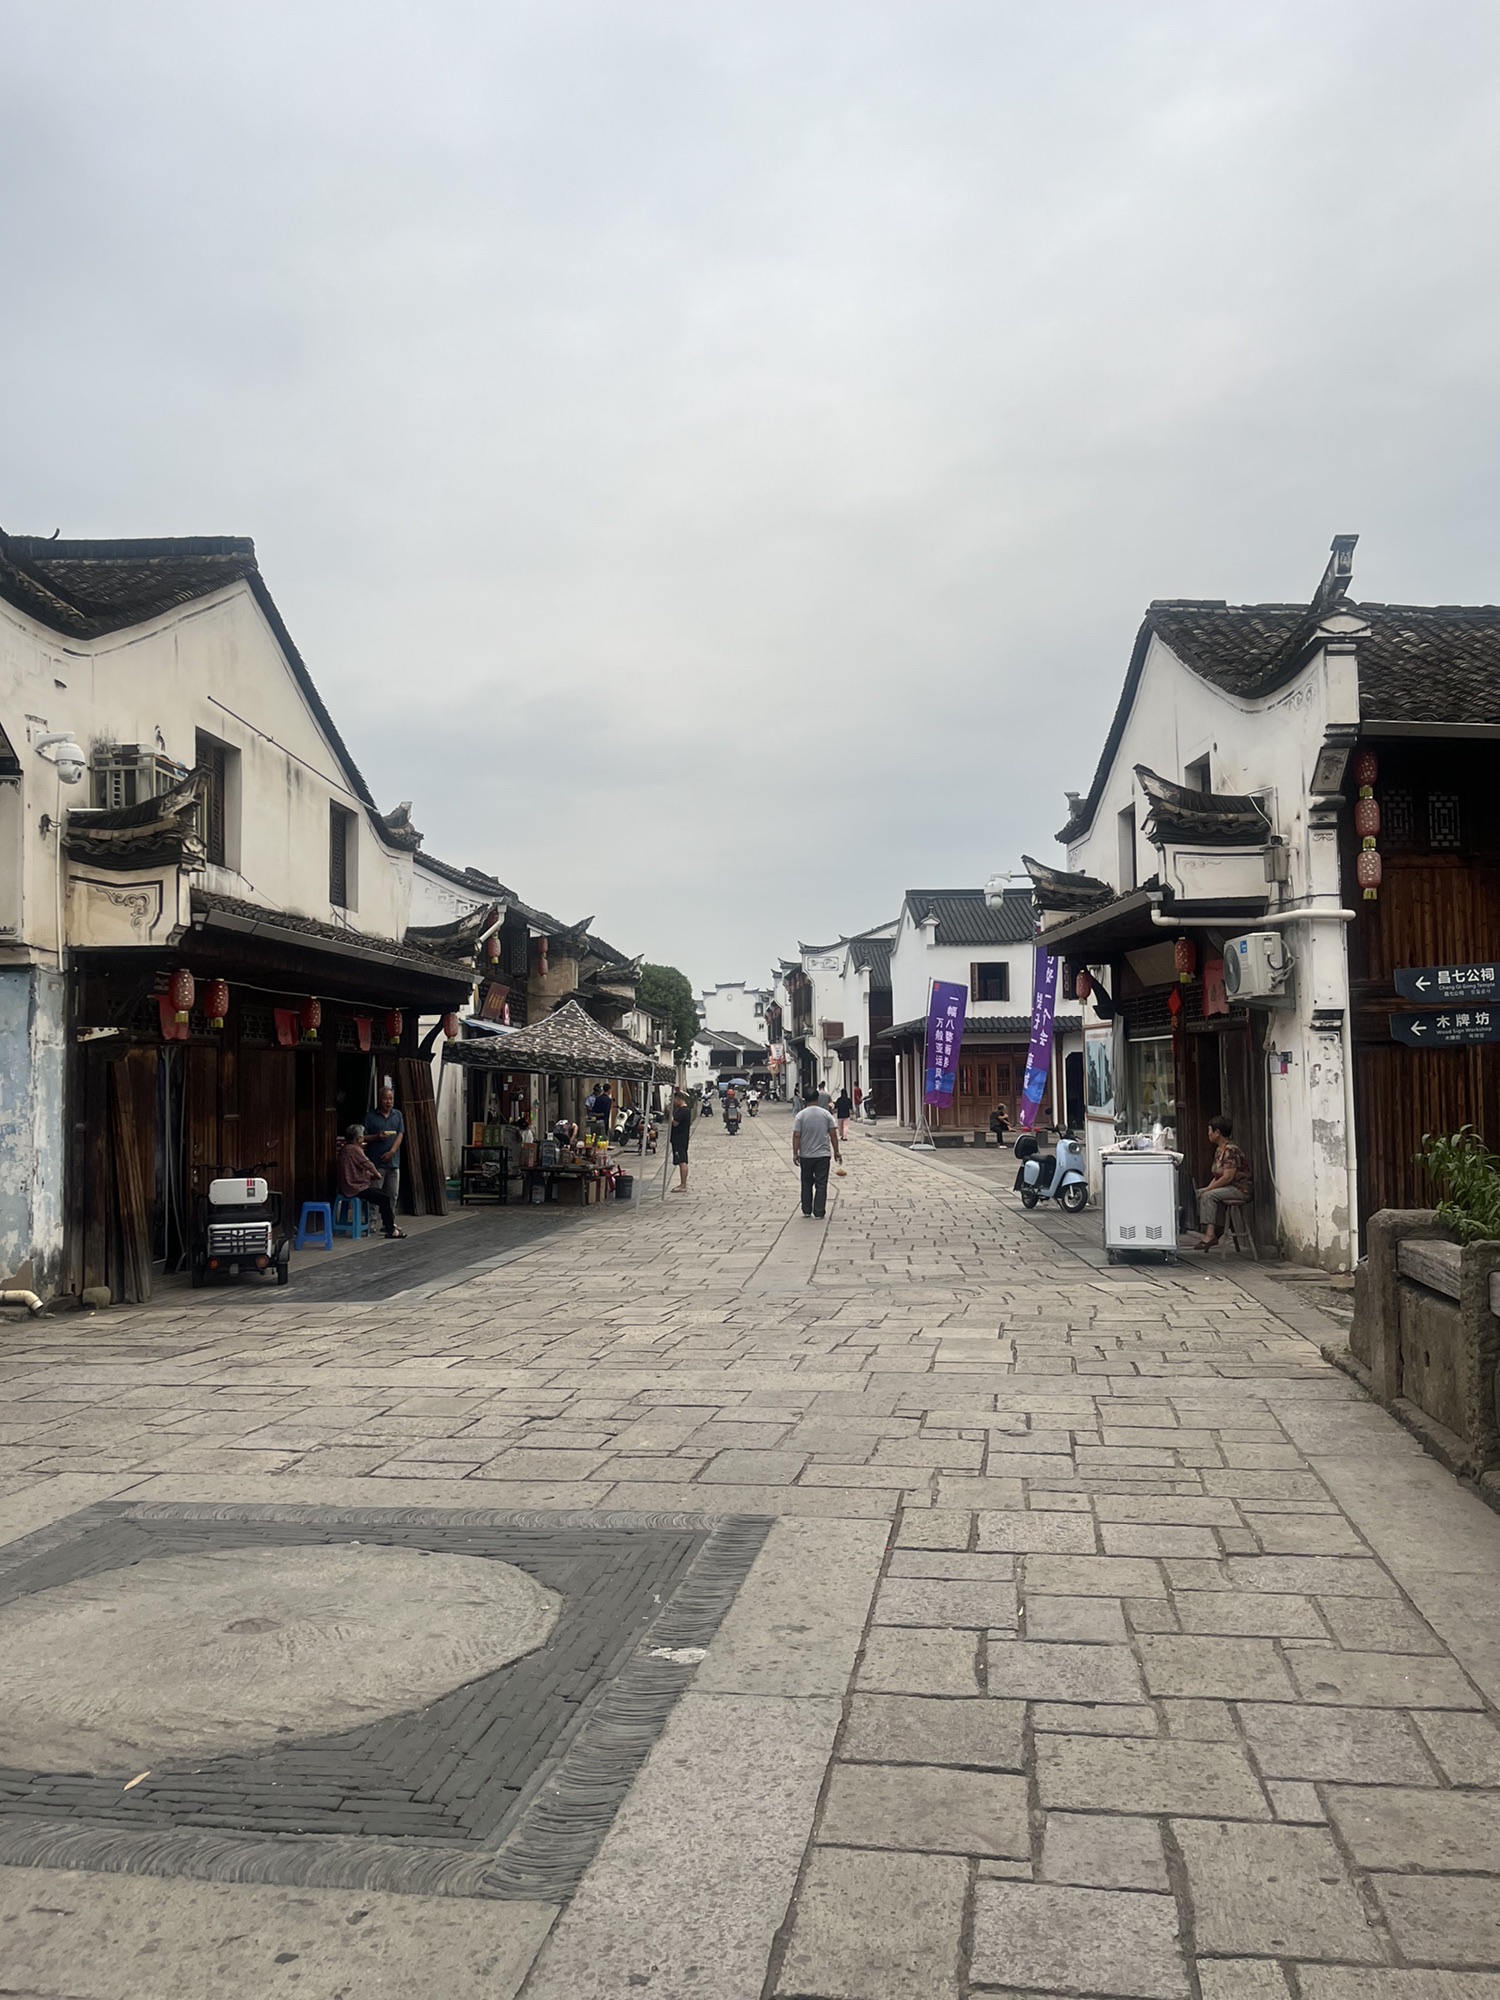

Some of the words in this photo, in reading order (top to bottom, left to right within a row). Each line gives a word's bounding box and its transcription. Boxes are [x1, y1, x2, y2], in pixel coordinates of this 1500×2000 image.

[1438, 968, 1495, 984] 昌七公祠
[1436, 1012, 1490, 1028] 木牌坊
[943, 996, 959, 1068] 一幅八婺画卷
